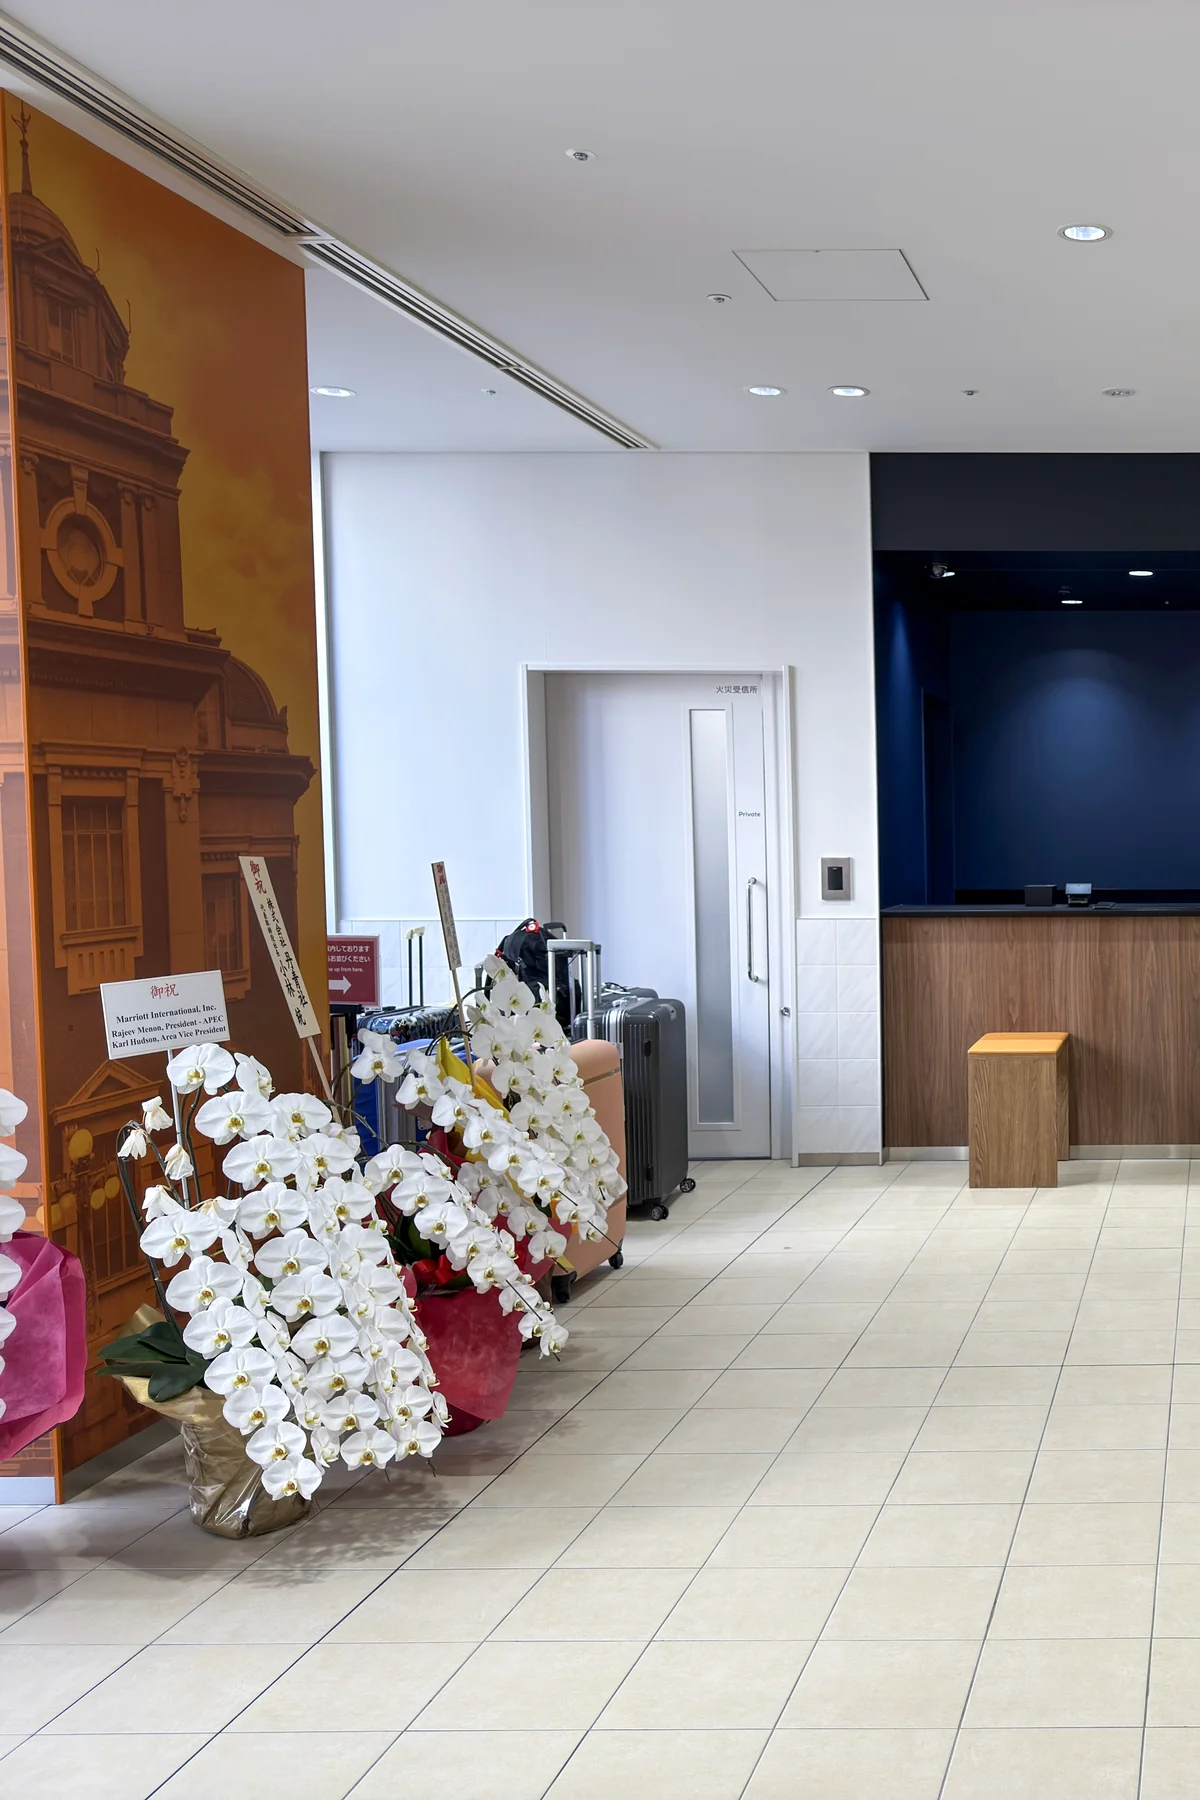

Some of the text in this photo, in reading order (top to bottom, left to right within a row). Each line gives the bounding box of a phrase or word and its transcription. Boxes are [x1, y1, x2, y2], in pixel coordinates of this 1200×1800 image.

[715, 685, 758, 694] 火災受信所
[249, 859, 267, 894] 御祝
[150, 983, 179, 999] 御祝
[116, 1004, 217, 1024] Marriott International, Inc.
[111, 1028, 135, 1038] Rajeev
[137, 1024, 164, 1035] Menon,
[165, 1019, 197, 1030] President
[202, 1014, 224, 1025] APEC
[112, 1025, 227, 1049] Karl Hudson, Area Vice President
